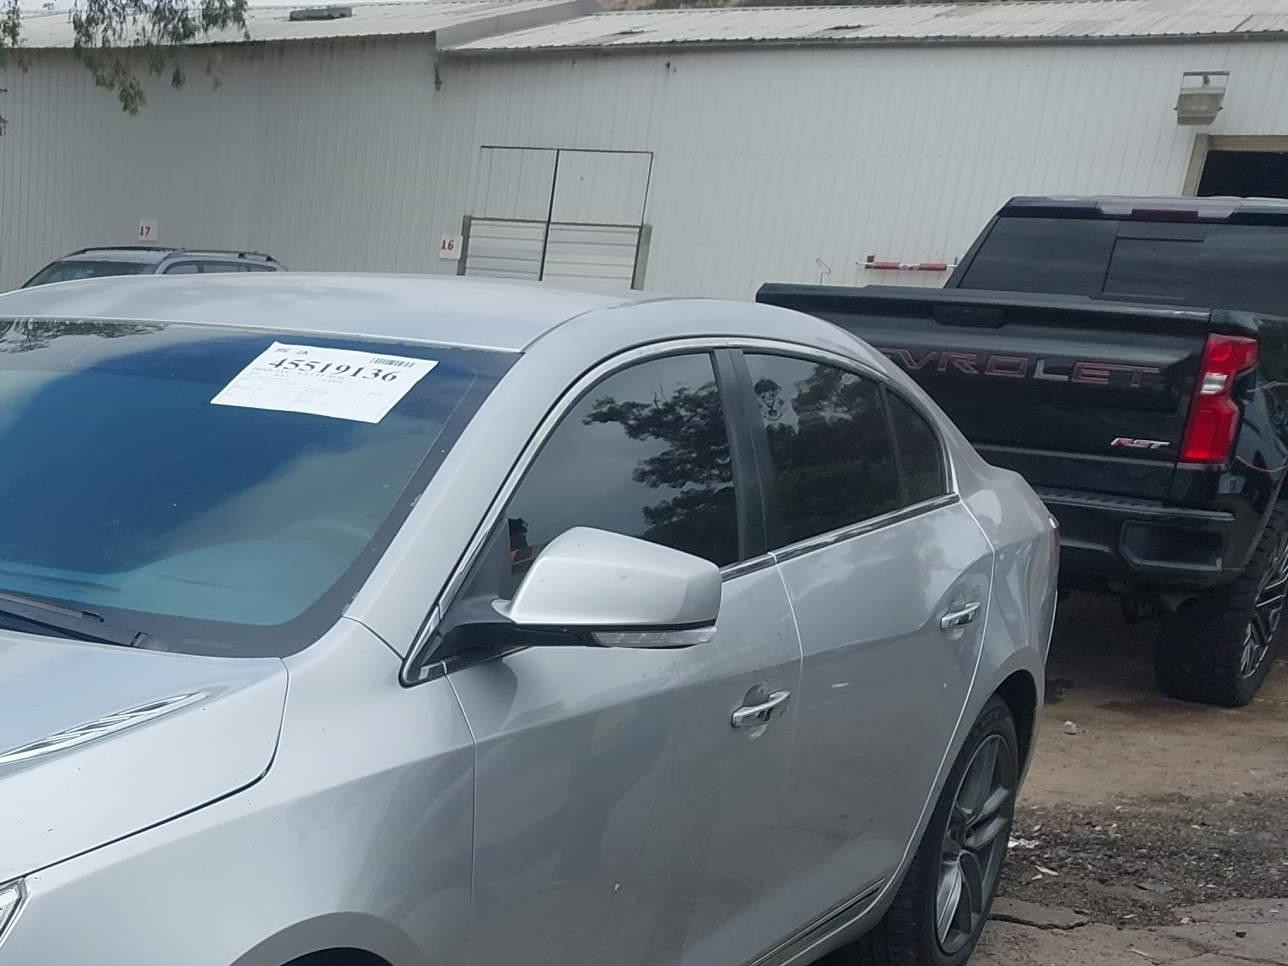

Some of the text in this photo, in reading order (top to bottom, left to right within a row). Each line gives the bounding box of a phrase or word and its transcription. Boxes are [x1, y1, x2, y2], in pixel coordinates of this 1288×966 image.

[140, 225, 151, 237] 17
[441, 239, 454, 250] 16
[269, 358, 398, 382] 45519136
[1111, 437, 1170, 449] RST
